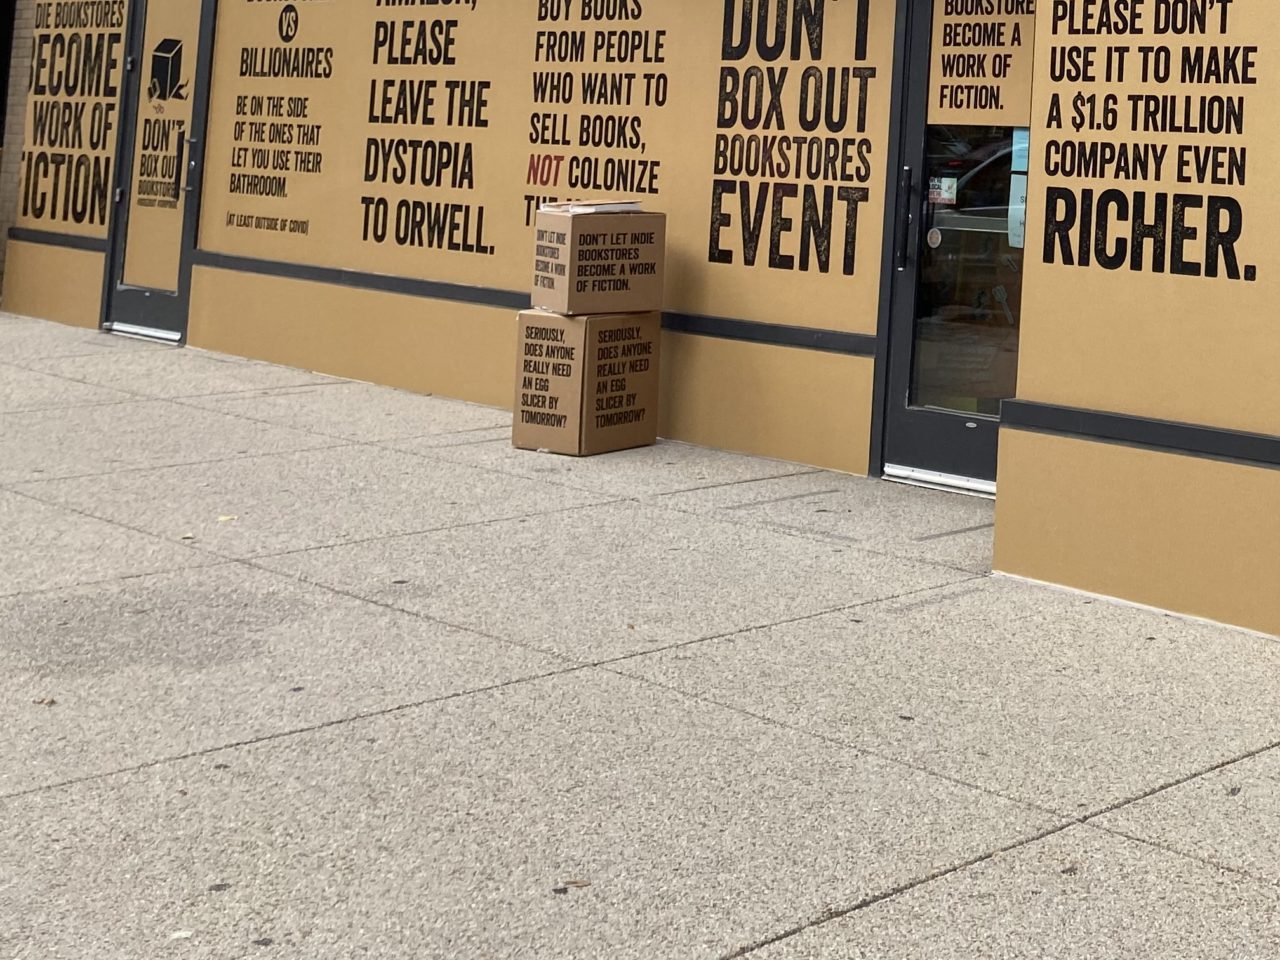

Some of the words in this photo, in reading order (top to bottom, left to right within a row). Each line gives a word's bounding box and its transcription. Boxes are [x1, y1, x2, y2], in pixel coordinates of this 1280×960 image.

[54, 0, 124, 28] BOOKSTORES
[372, 19, 458, 65] PLEASE
[534, 31, 584, 62] FROM
[592, 30, 666, 63] PEOPLE
[239, 46, 333, 78] BILLIONAIRES
[1050, 45, 1096, 82] USE
[1105, 45, 1129, 82] IT
[1138, 45, 1171, 83] TO
[1180, 45, 1258, 84] MAKE
[368, 79, 437, 125] LEAVE
[444, 80, 490, 127] THE
[532, 71, 572, 104] WHO
[581, 72, 636, 106] WANT
[643, 73, 668, 107] TO
[236, 95, 248, 115] BE
[250, 96, 263, 116] ON
[266, 96, 284, 117] THE
[286, 97, 308, 118] SIDE
[1045, 92, 1062, 129] A
[1071, 91, 1118, 132] $1.6
[1127, 93, 1244, 134] TRILLION
[32, 100, 85, 150] WORK
[89, 102, 115, 151] OF
[233, 121, 246, 141] OF
[248, 122, 265, 143] THE
[268, 123, 293, 145] ONES
[296, 124, 321, 145] THAT
[528, 112, 570, 146] SELL
[578, 114, 646, 154] BOOKS,
[231, 147, 249, 167] LET
[251, 148, 269, 169] YOU
[272, 150, 290, 171] USE
[294, 151, 322, 173] THEIR
[363, 137, 474, 189] DYSTOPIA
[525, 153, 564, 187] NOT
[567, 156, 660, 194] COLONIZE
[1044, 140, 1168, 181] COMPANY
[1176, 144, 1246, 186] EVEN
[360, 196, 388, 243] TO
[394, 199, 495, 255] ORWELL.
[578, 233, 608, 245] DON'T
[610, 232, 627, 245] LET
[630, 232, 655, 244] INDIE
[1042, 185, 1257, 281] RICHER.
[577, 263, 616, 277] BECOME
[619, 263, 625, 275] A
[628, 262, 656, 275] WORK
[578, 248, 639, 261] BOOKSTORES
[576, 280, 589, 293] OF
[592, 279, 630, 291] FICTION.
[524, 326, 565, 344] SERIOUSLY,
[524, 342, 543, 358] DOES
[544, 345, 575, 361] ANYONE
[523, 359, 549, 375] REALLY
[552, 362, 571, 377] NEED
[521, 376, 532, 390] AN
[534, 378, 549, 392] EGG
[521, 393, 546, 409] SLICER
[548, 396, 558, 410] BY
[520, 409, 567, 428] TOMORROW?
